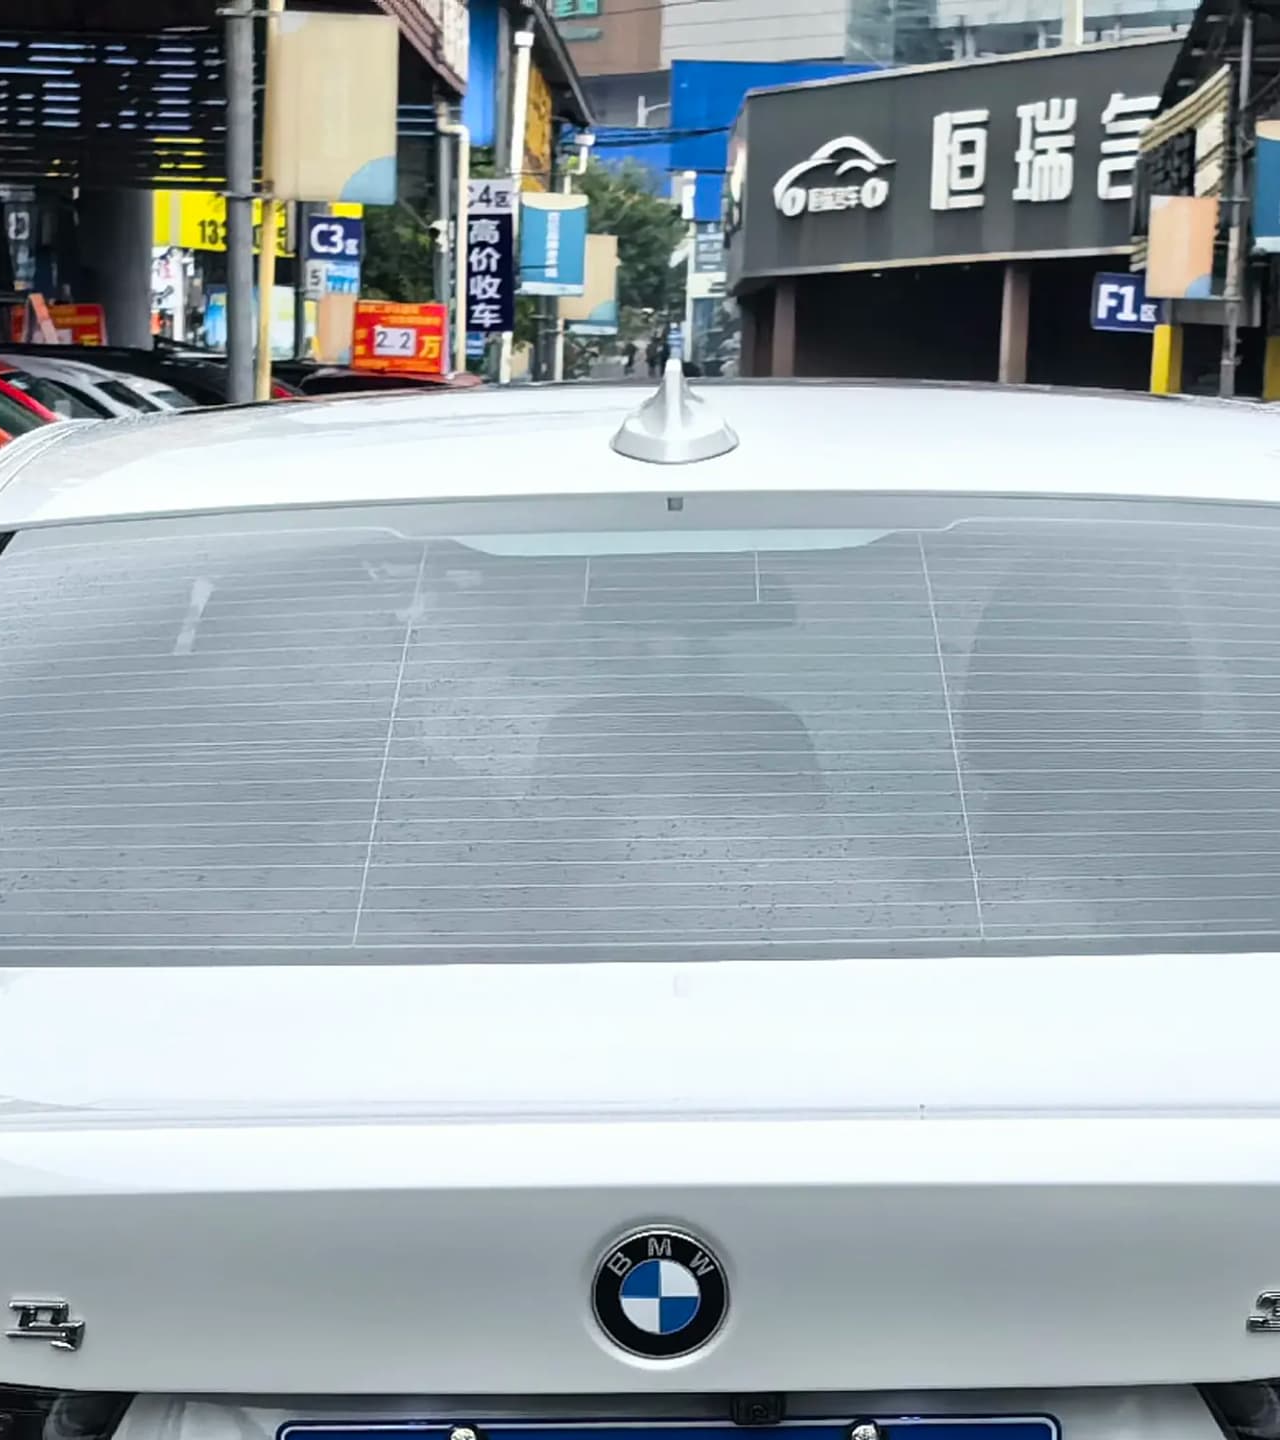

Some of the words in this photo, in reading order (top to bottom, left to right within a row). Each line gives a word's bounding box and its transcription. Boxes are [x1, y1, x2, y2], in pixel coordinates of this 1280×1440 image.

[469, 218, 503, 328] 高价收车
[1097, 283, 1158, 323] F1区
[606, 1236, 716, 1277] BMW
